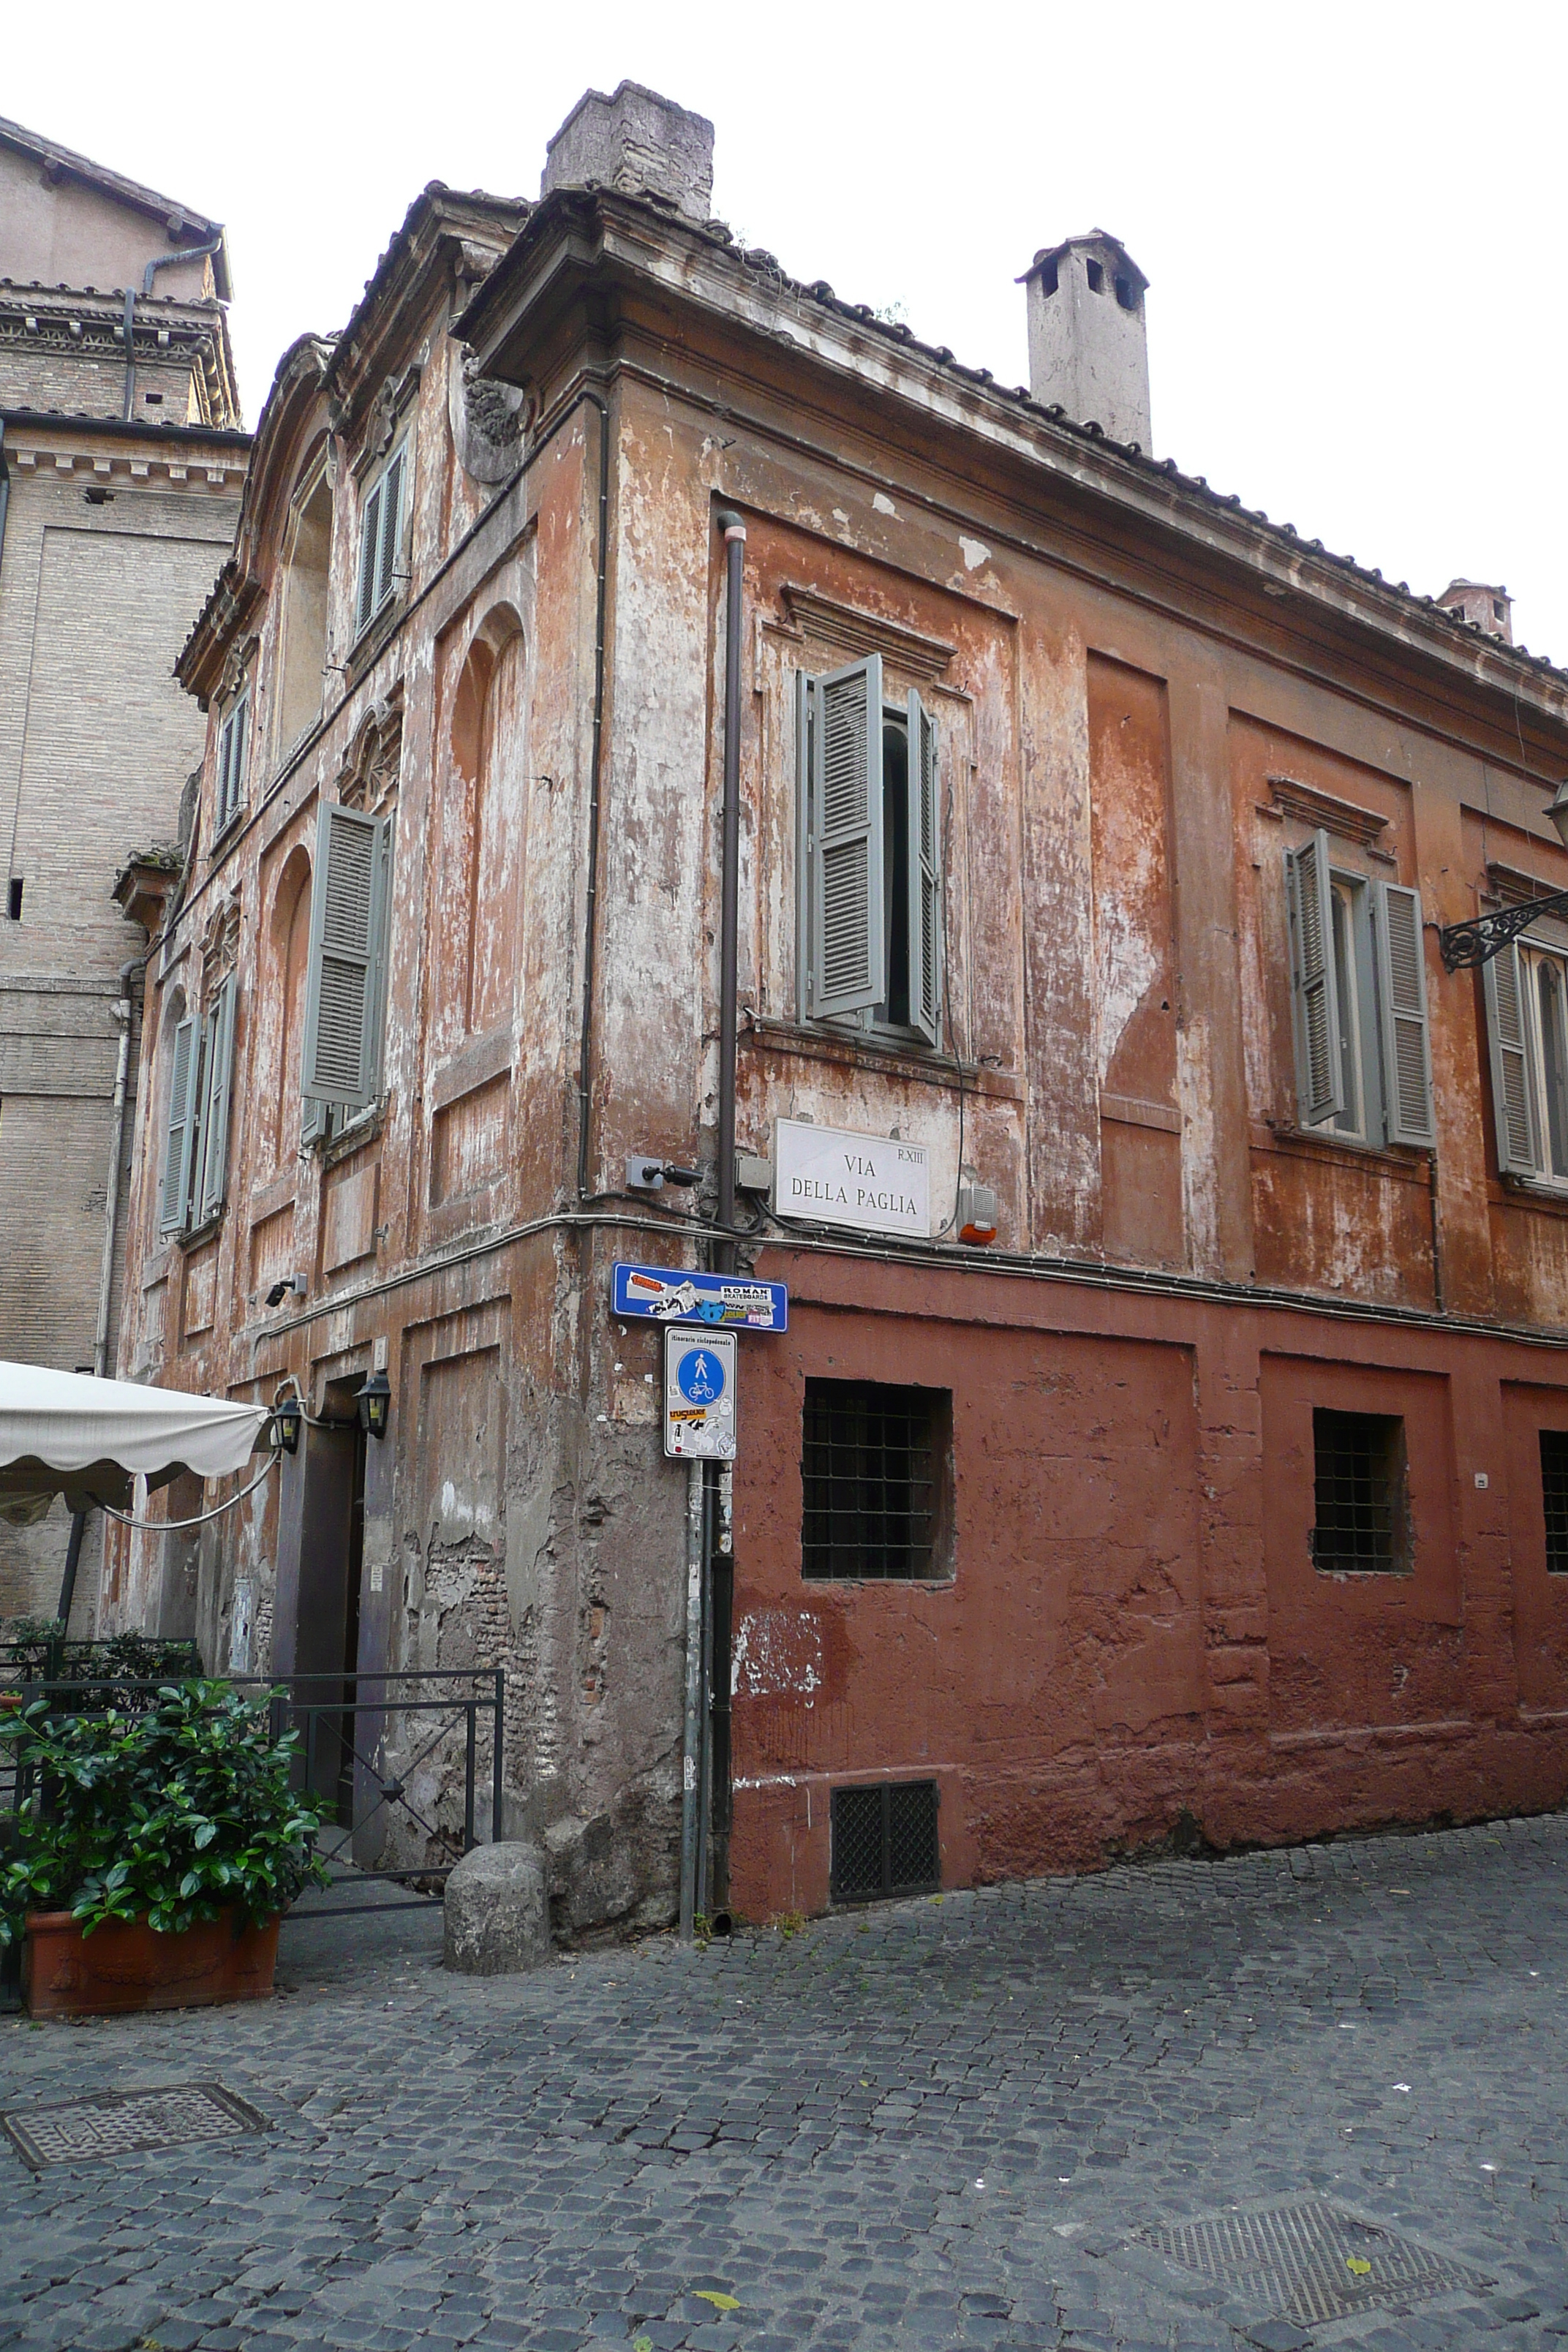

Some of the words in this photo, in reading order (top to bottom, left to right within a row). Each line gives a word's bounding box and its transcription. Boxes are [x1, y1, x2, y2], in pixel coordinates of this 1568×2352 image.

[897, 1148, 924, 1164] R.XIII
[844, 1155, 876, 1177] VIA
[792, 1177, 848, 1204] DELLA
[856, 1188, 917, 1215] PAGLIA
[671, 1335, 696, 1343] itinerario
